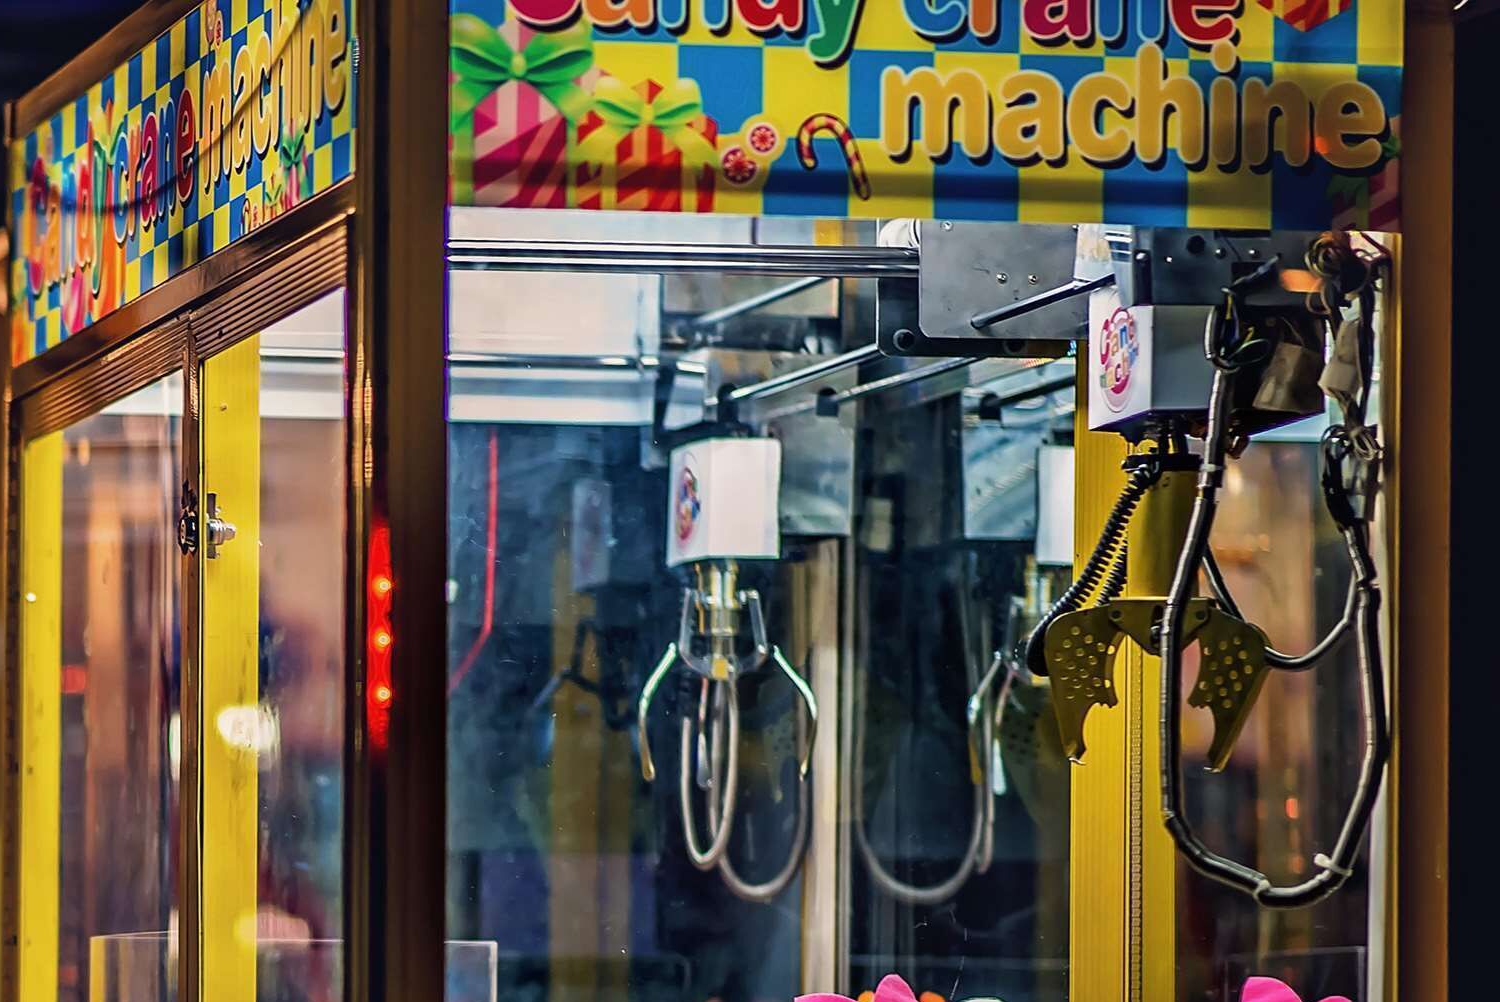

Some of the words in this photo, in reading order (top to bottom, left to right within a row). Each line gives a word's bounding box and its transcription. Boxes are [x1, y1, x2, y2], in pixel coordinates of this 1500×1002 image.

[27, 118, 108, 296] Candy
[112, 88, 197, 245] crane
[198, 0, 348, 195] machine
[880, 39, 1388, 170] machine
